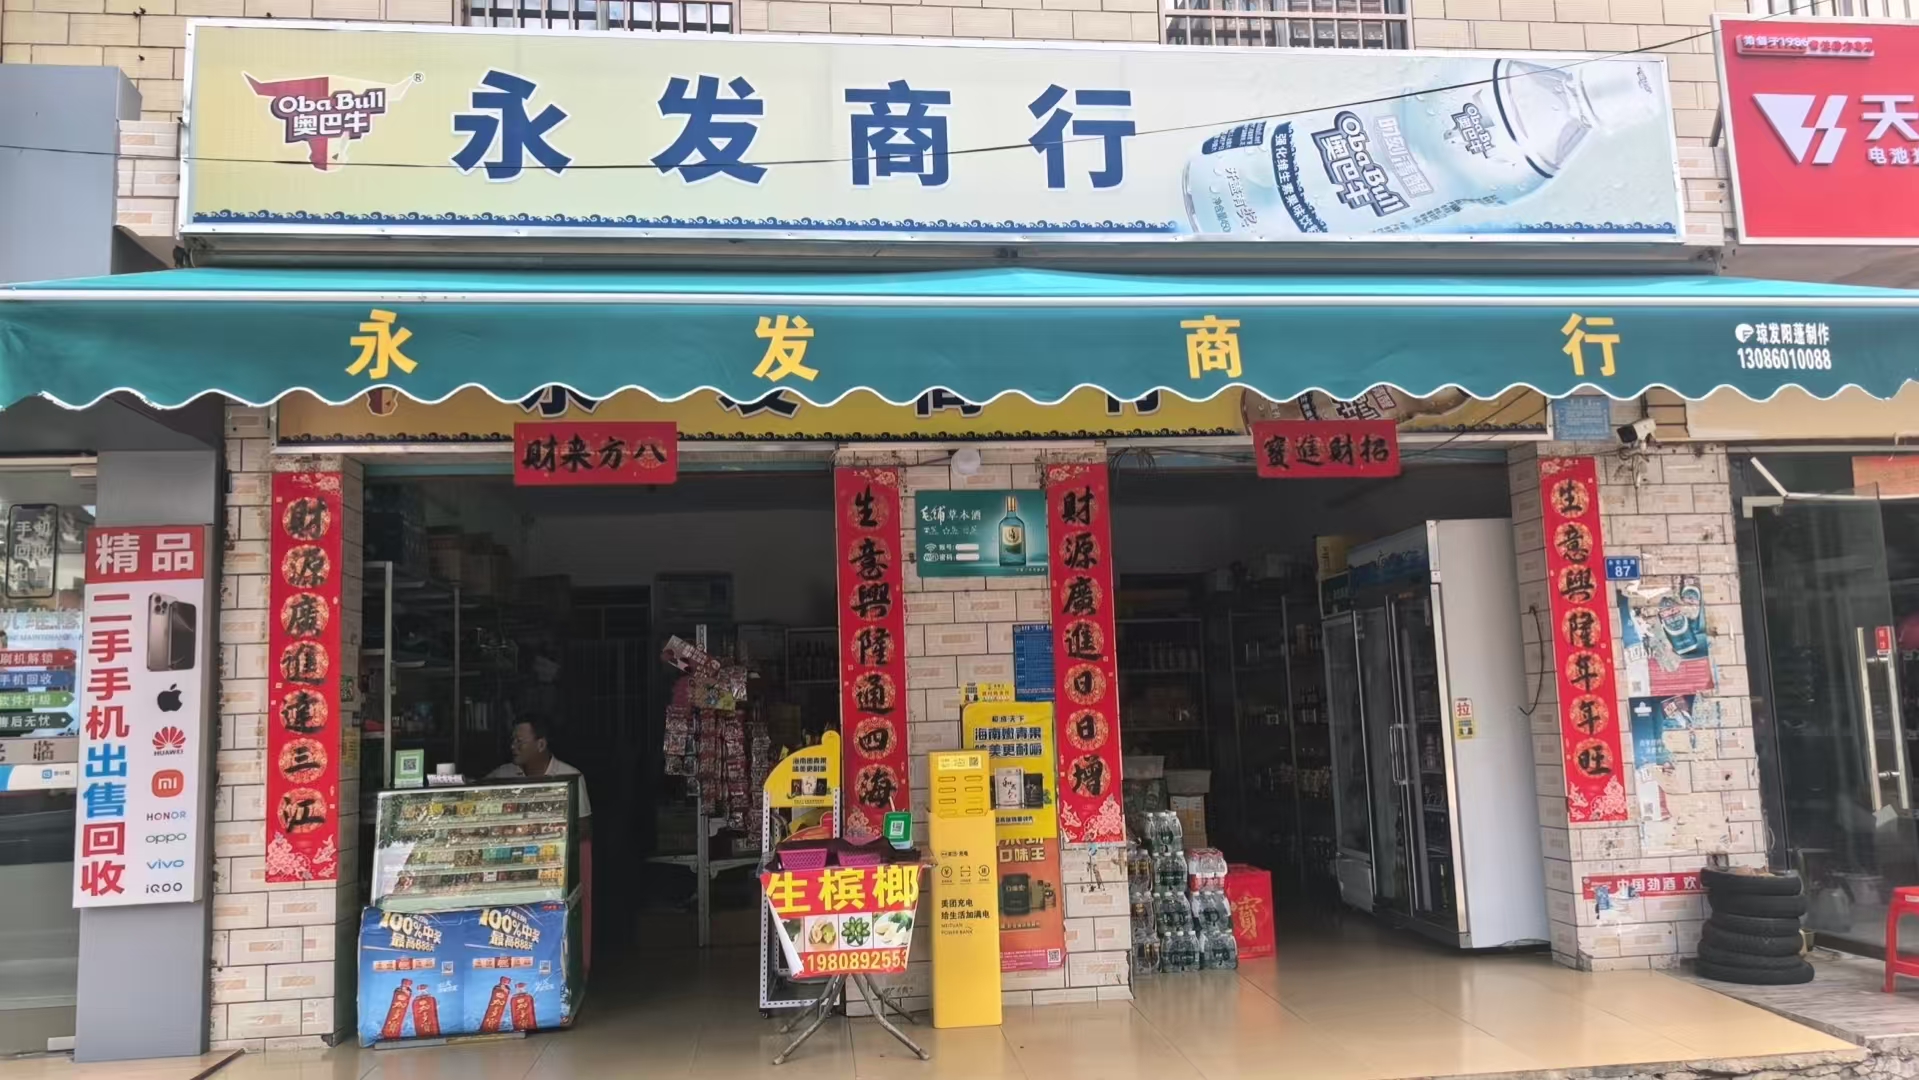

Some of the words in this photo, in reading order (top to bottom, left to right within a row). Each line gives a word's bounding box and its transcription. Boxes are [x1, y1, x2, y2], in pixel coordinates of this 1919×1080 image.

[278, 95, 332, 113] Oba
[335, 90, 384, 110] Bull
[293, 110, 368, 136] 奥巴牛
[453, 70, 1136, 188] 永发商行
[1320, 134, 1371, 205] 奥巴牛
[1362, 167, 1404, 214] Bull
[1737, 348, 1832, 370] 13086010088
[96, 532, 195, 574] 精品
[1615, 566, 1631, 577] 87
[1457, 702, 1471, 717] 拉
[80, 592, 133, 897] 二手手机出售回收
[154, 749, 184, 757] HUAWEI
[146, 811, 187, 821] HONOR
[146, 859, 185, 870] vivo
[999, 847, 1045, 863] 口味王
[146, 883, 183, 894] iQOO
[766, 865, 919, 912] 生槟榔
[941, 899, 973, 908] 美团充电
[941, 910, 990, 920] 给生活加满电
